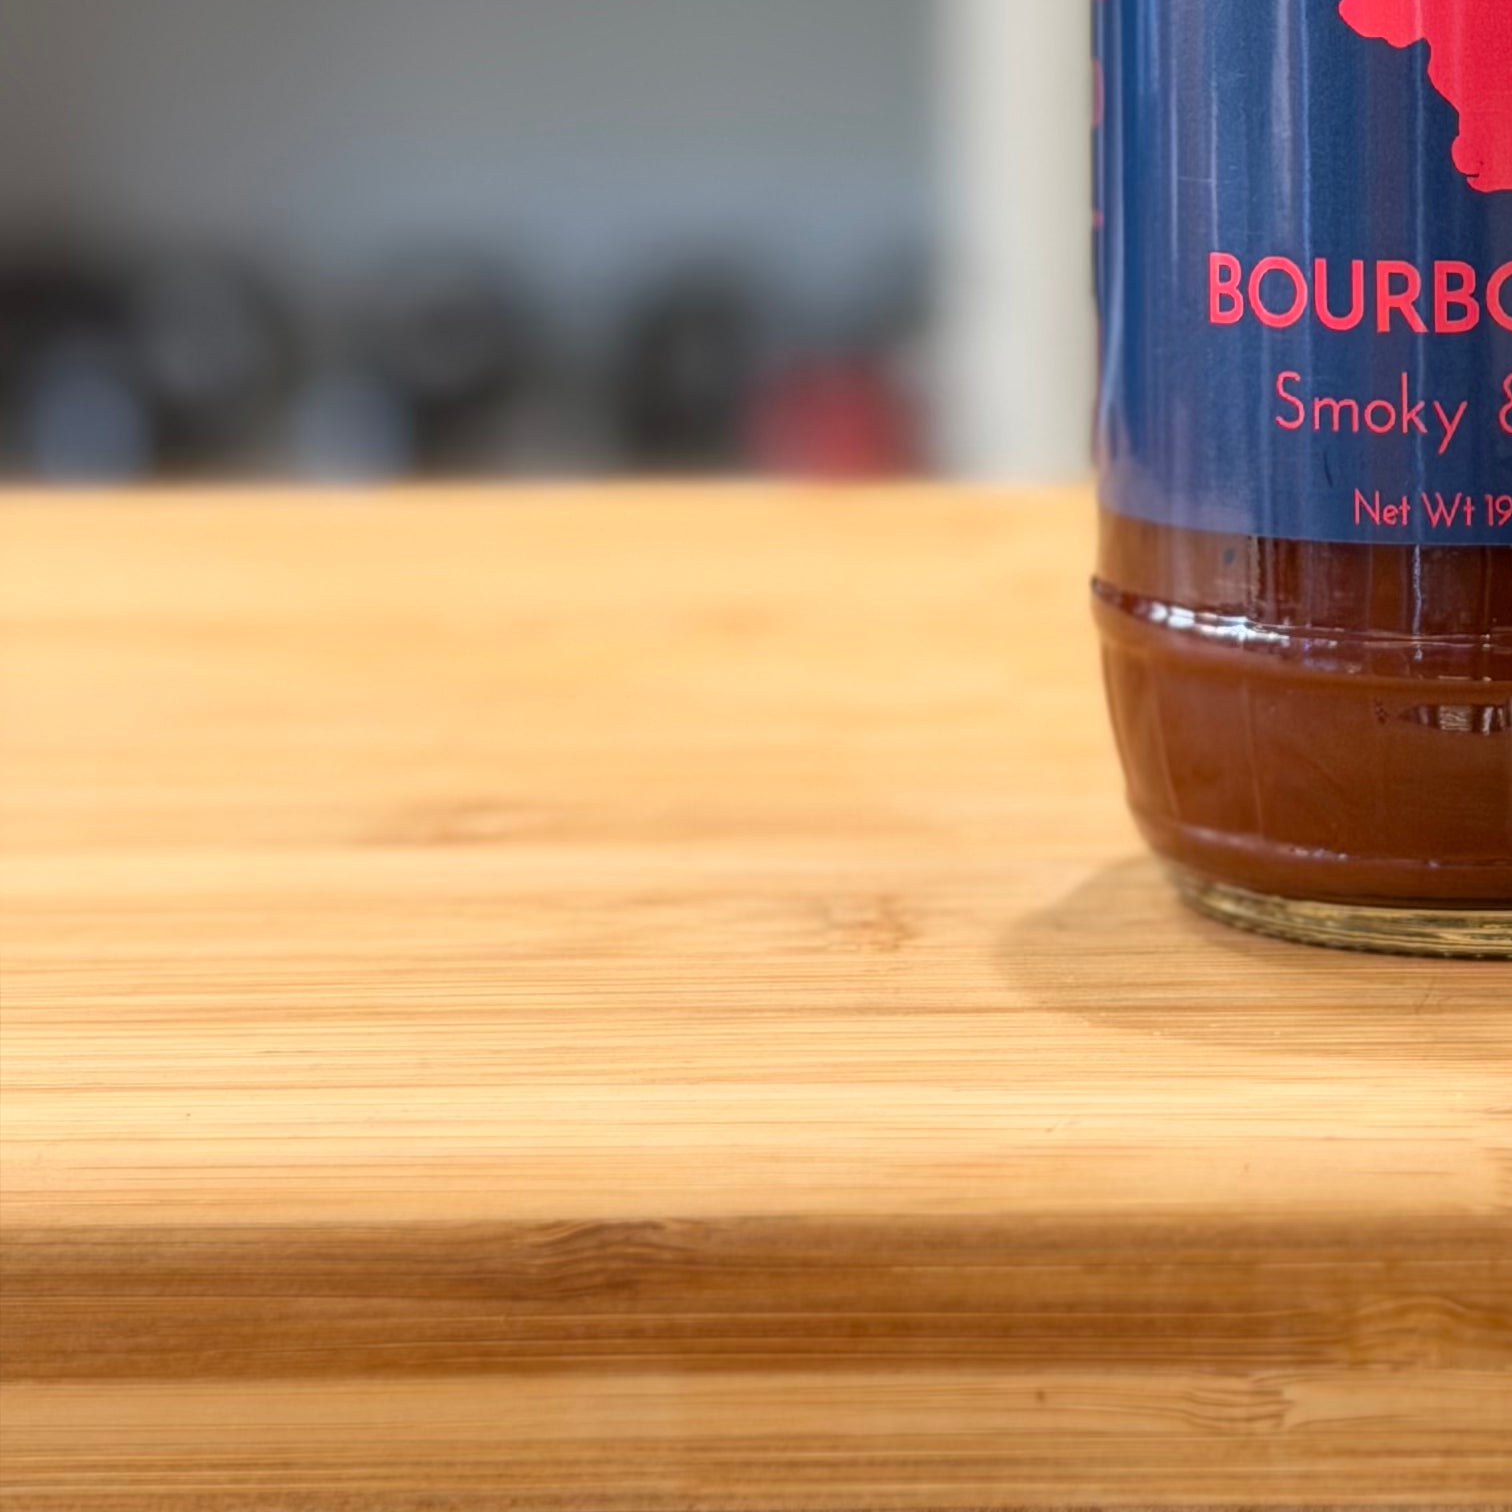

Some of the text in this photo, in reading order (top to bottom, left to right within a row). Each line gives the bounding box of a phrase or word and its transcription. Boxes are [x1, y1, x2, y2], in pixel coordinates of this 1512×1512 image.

[1275, 370, 1466, 455] Smoky
[1353, 488, 1410, 526] Net
[1421, 492, 1475, 528] Wt
